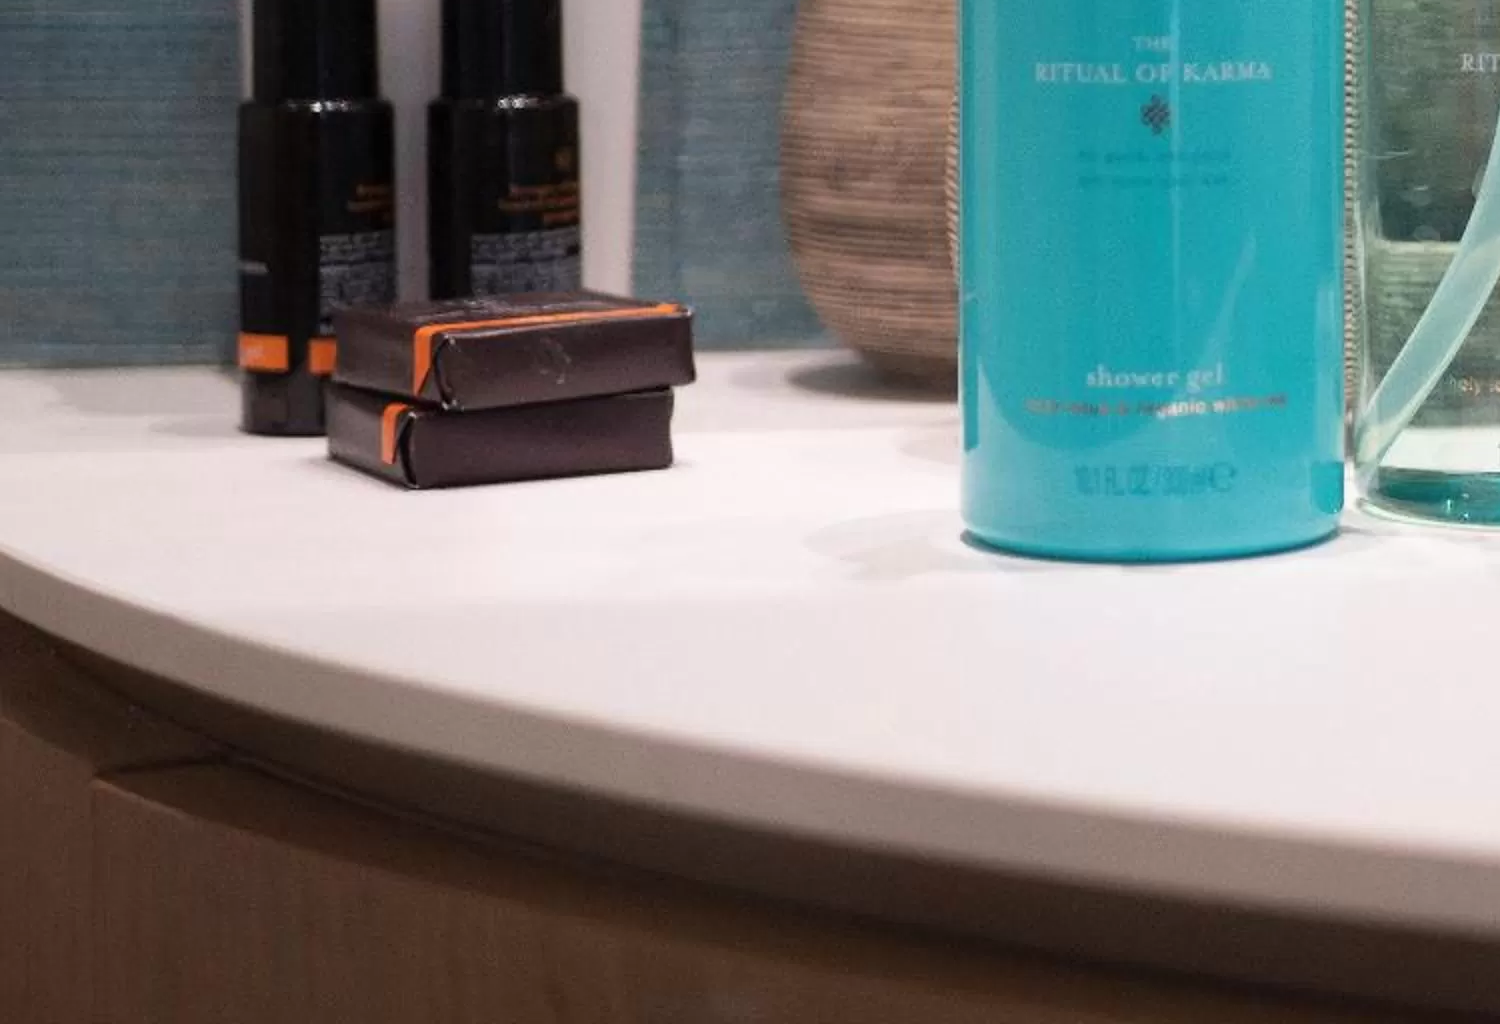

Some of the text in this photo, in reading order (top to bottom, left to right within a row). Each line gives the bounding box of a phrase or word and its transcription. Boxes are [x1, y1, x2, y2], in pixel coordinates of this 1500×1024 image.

[1131, 35, 1174, 51] THE
[1034, 60, 1274, 83] RITUAL OF KARMA
[1086, 362, 1225, 394] shower gel
